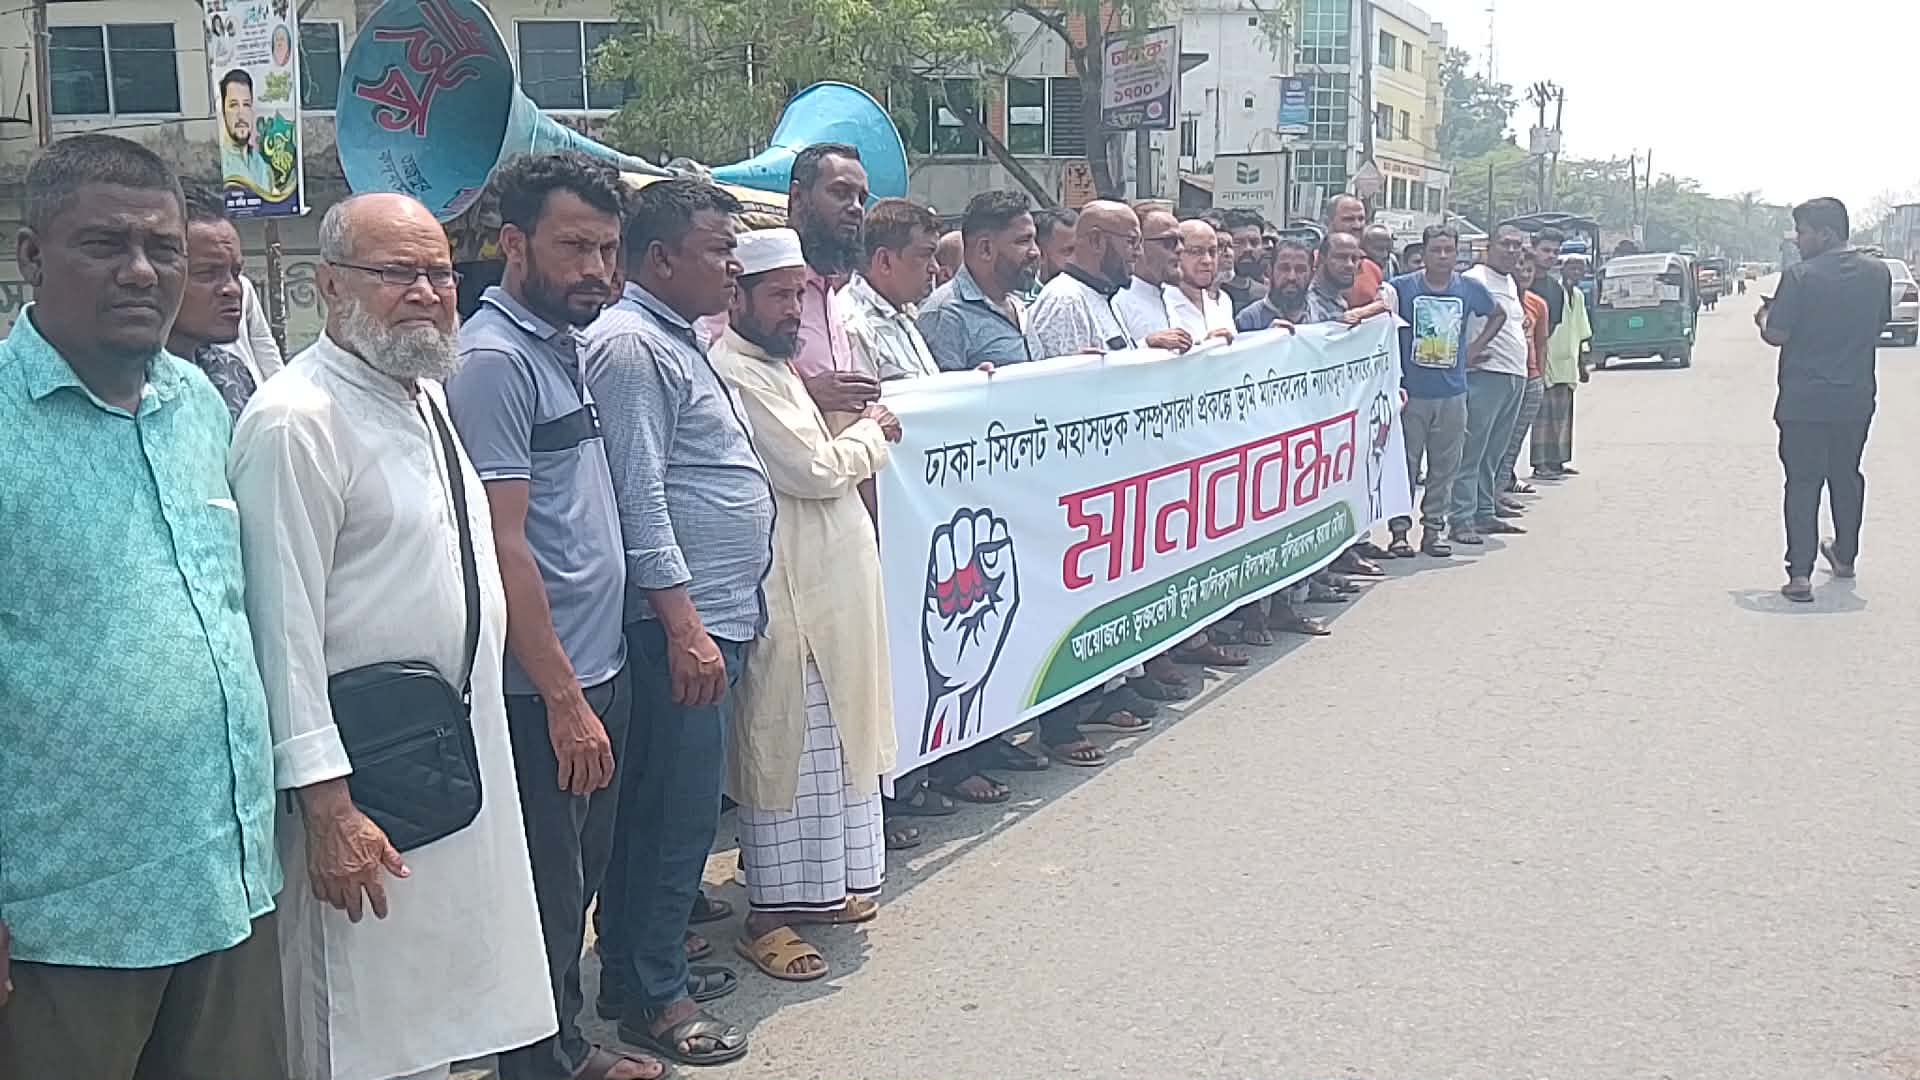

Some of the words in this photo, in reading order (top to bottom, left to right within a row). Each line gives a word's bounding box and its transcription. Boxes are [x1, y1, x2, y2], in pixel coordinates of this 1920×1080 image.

[924, 413, 1049, 488] ঢাকা-সিলেট
[1054, 410, 1130, 459] মহাসড়ক
[1133, 393, 1194, 441] সম্প্রসারণ
[1058, 408, 1360, 590] মানববন্ধন
